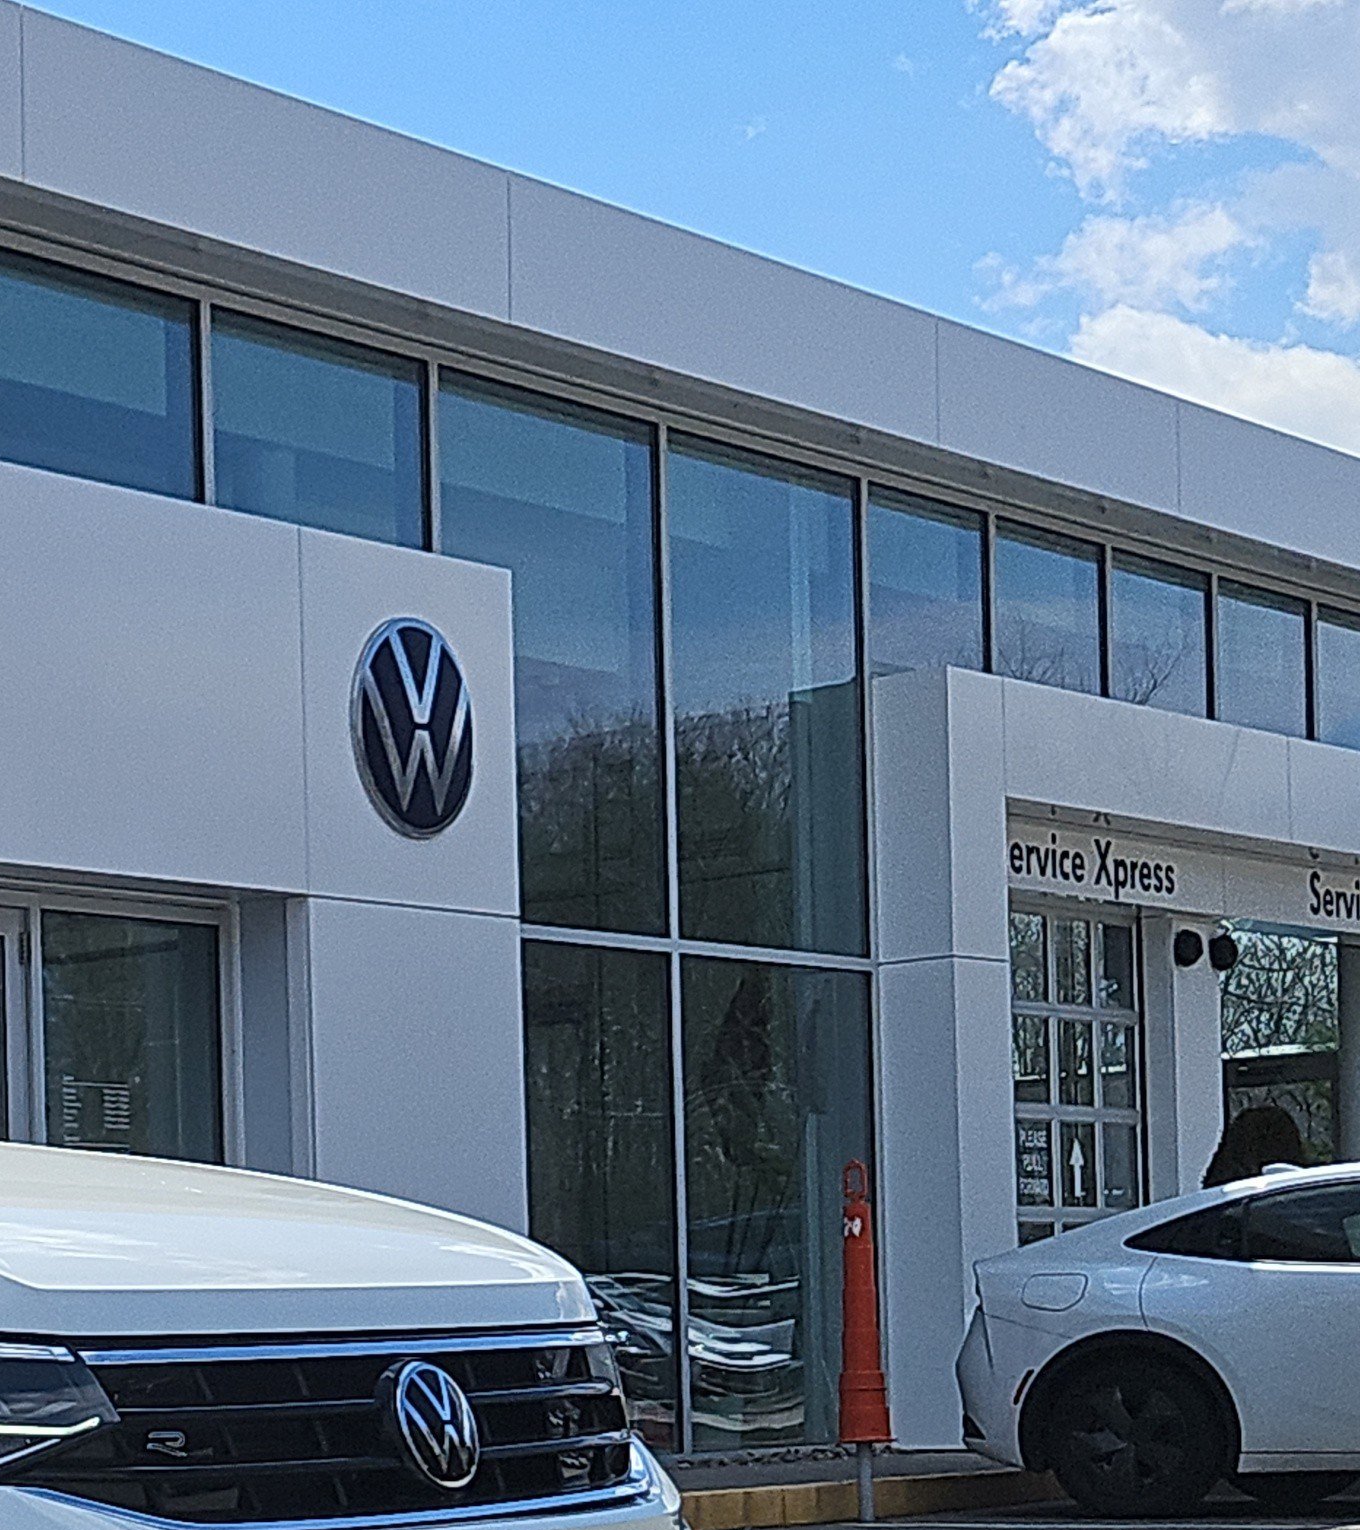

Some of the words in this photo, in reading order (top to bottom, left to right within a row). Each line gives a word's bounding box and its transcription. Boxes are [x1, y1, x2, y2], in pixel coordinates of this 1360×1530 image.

[1009, 832, 1086, 884] ervice
[1094, 838, 1176, 900] Xpress
[1309, 870, 1360, 921] Servi
